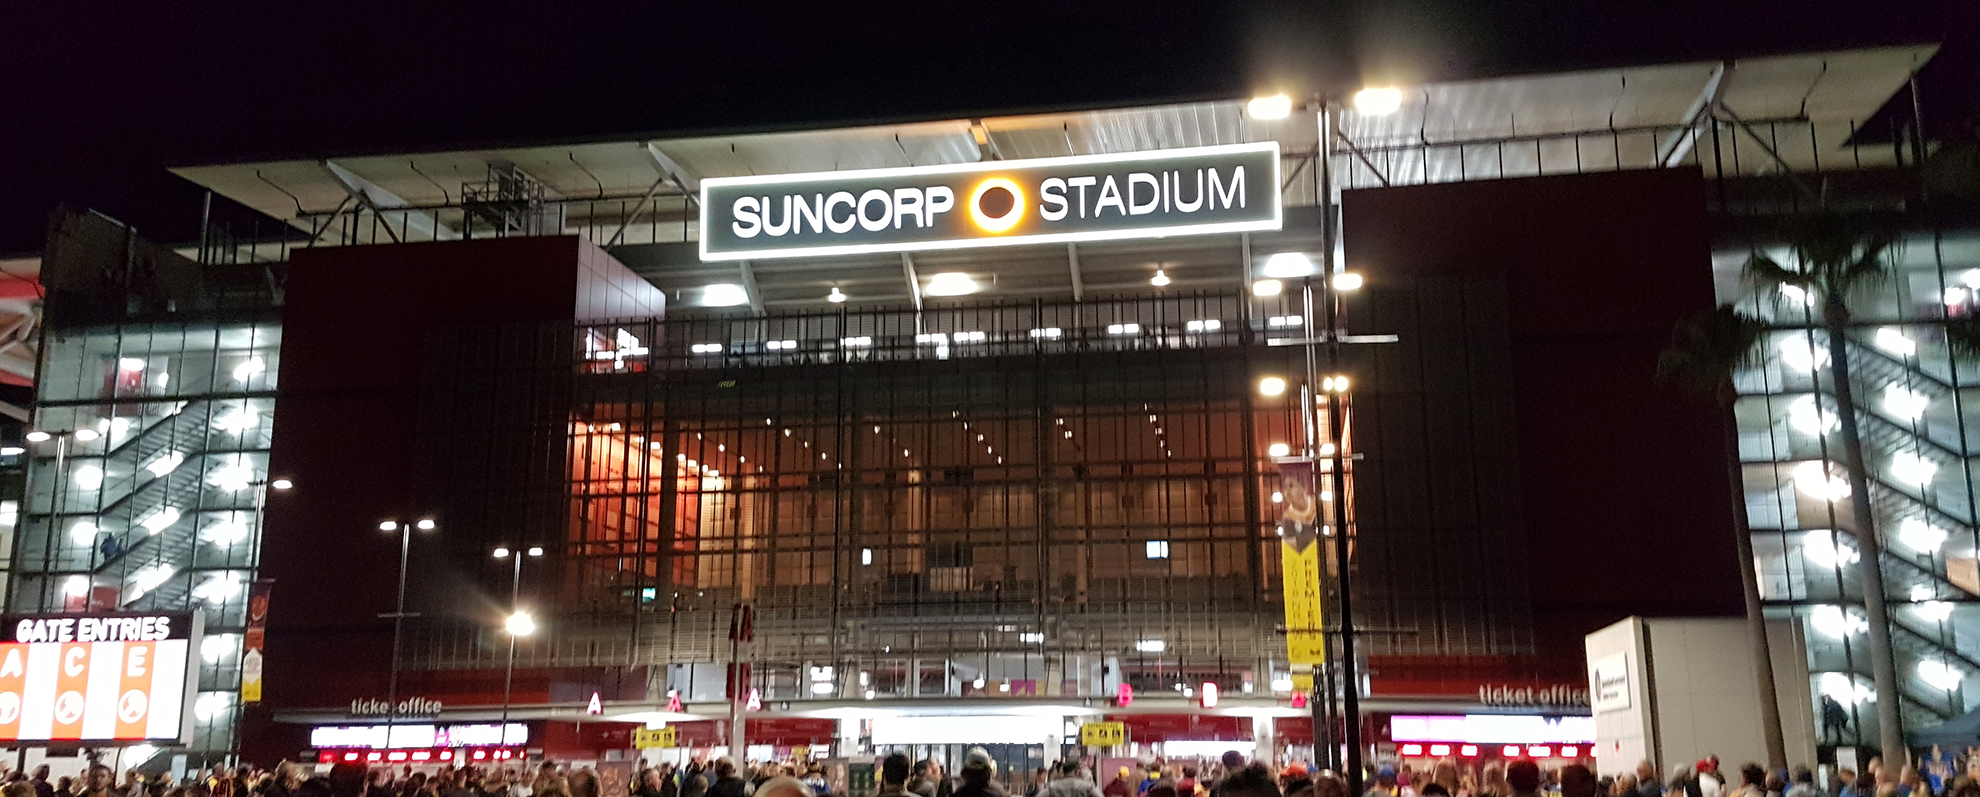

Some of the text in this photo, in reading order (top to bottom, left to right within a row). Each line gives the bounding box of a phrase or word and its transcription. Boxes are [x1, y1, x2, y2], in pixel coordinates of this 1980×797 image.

[732, 165, 1247, 239] SUNCORP STADIUM
[16, 616, 170, 643] GATE ENTRIES
[0, 648, 22, 678] A
[65, 646, 85, 677] C
[127, 646, 148, 677] E
[351, 697, 442, 715] ticke office
[587, 691, 602, 714] A
[667, 690, 682, 712] A
[746, 688, 762, 711] A
[1118, 682, 1134, 707] B
[1479, 684, 1533, 706] ticket
